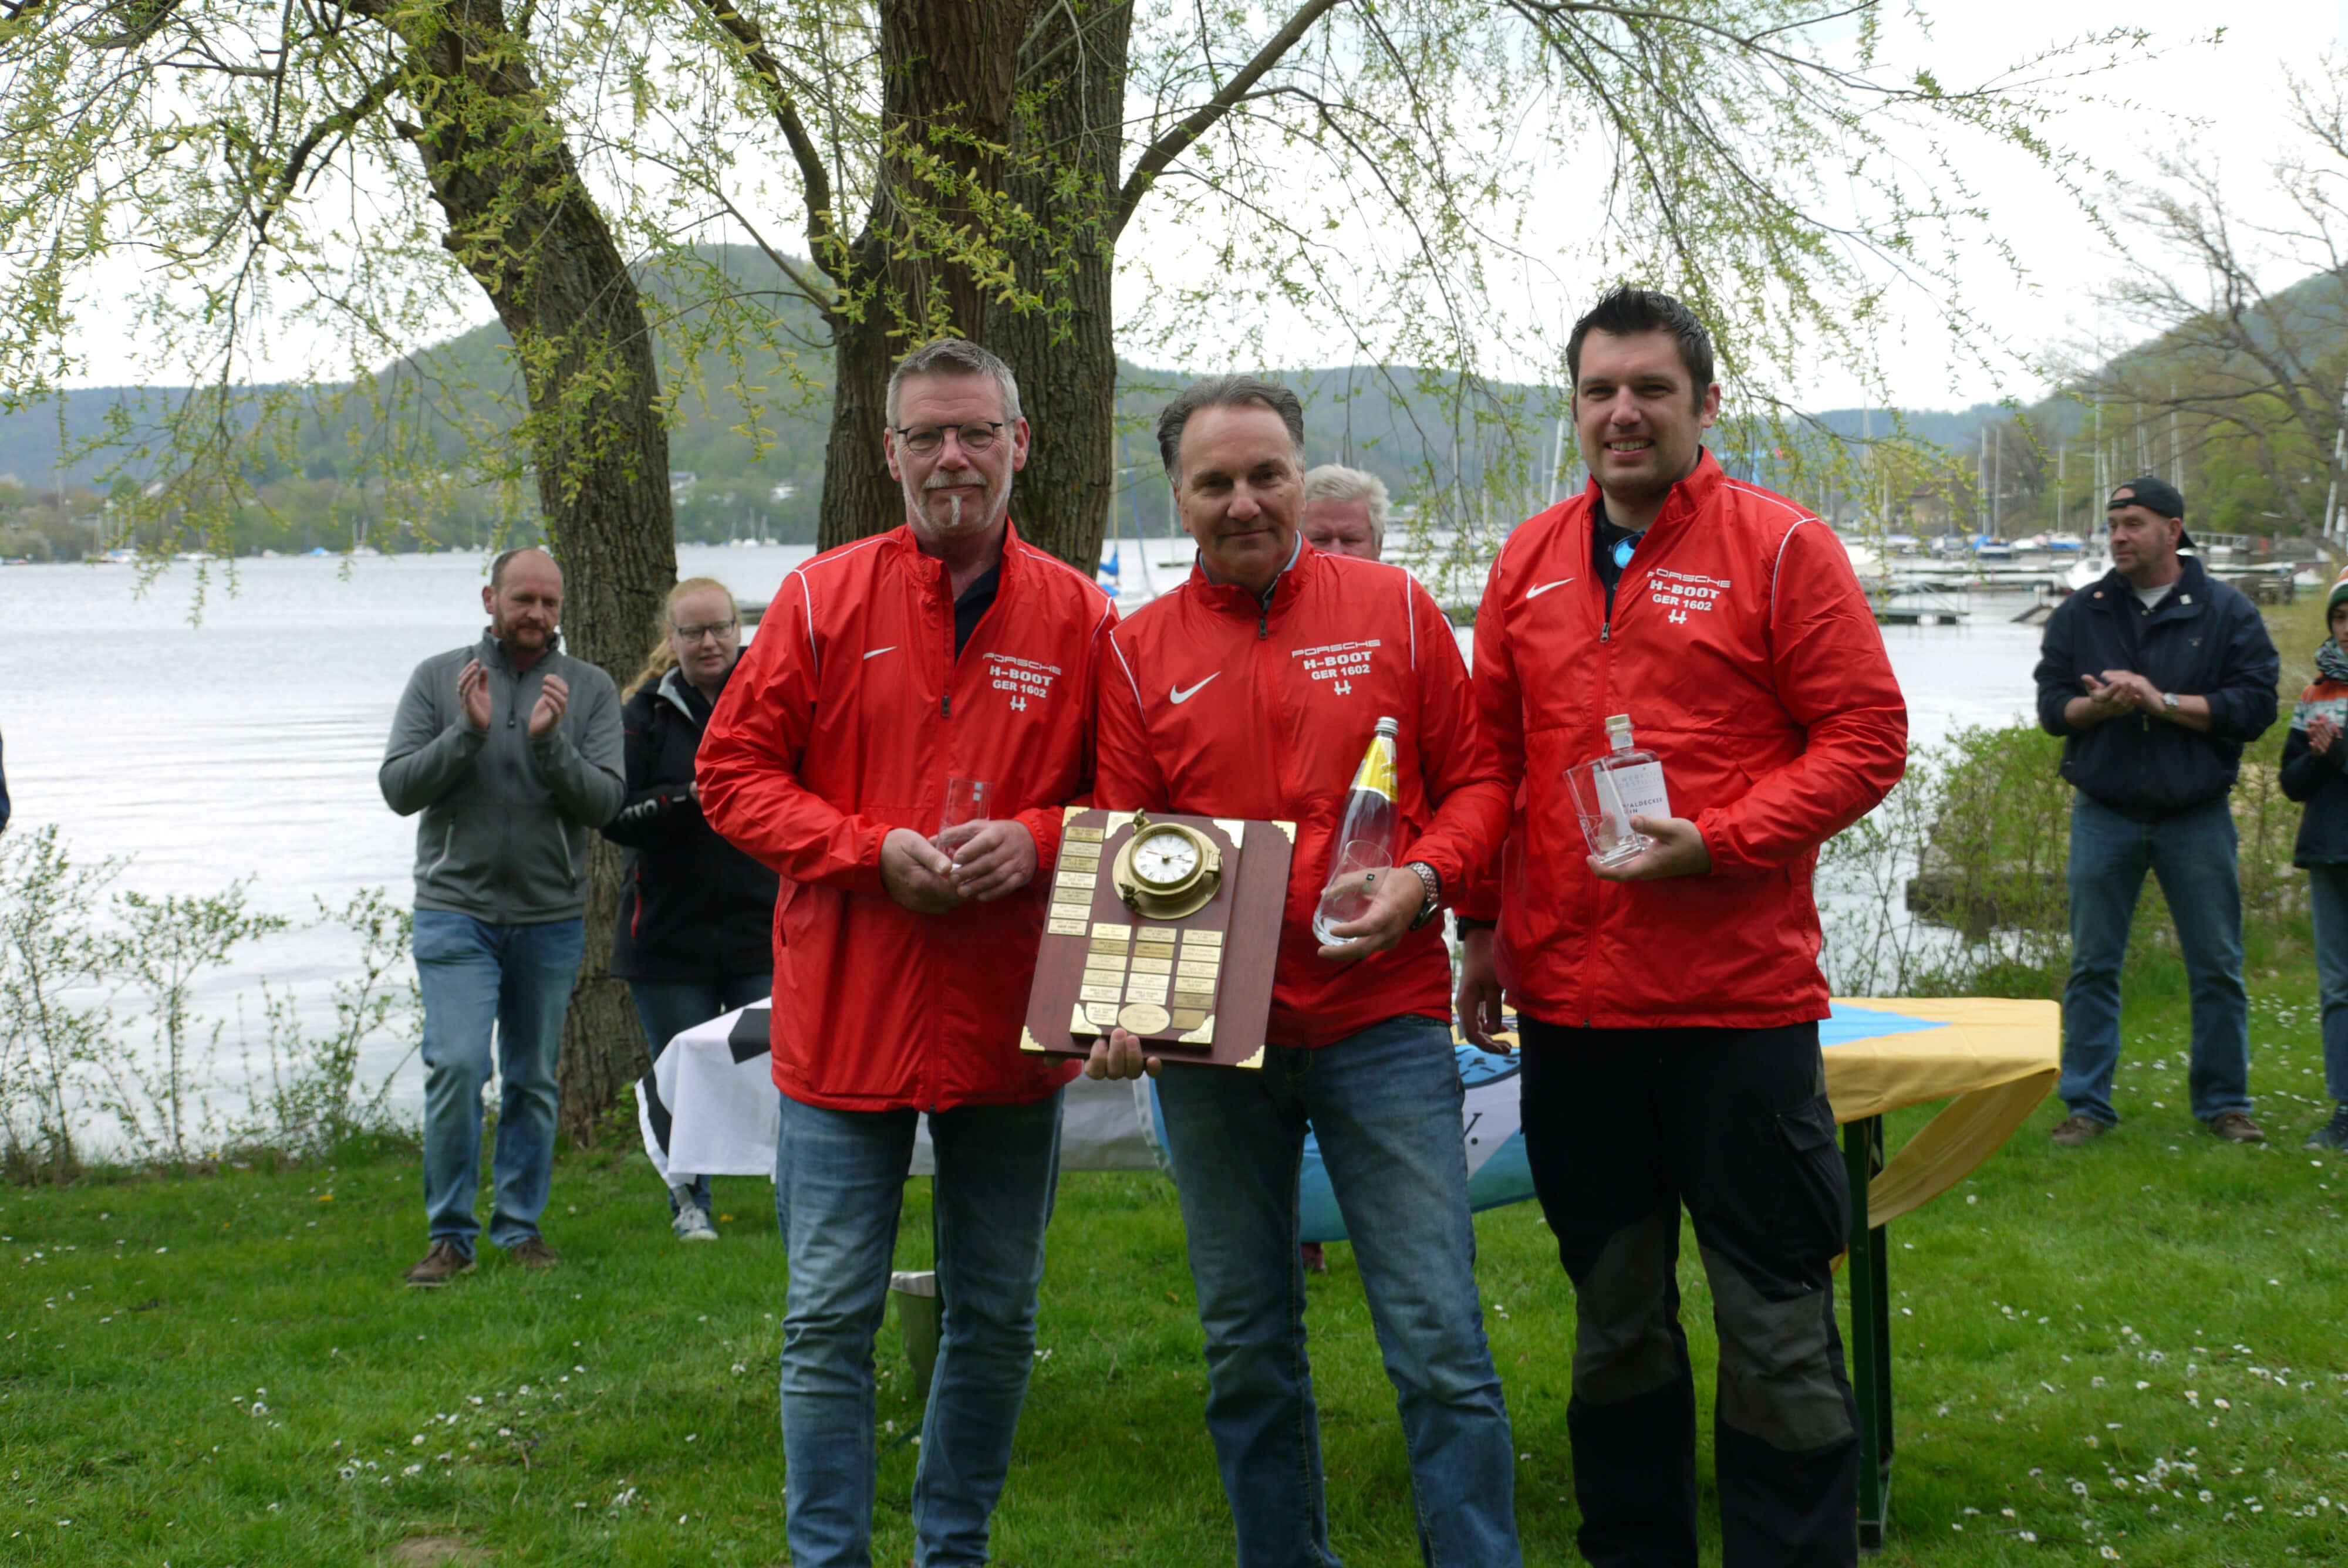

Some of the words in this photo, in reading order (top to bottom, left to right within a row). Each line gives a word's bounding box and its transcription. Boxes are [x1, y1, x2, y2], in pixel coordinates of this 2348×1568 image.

[1649, 579, 1720, 599] H-BOOT
[1653, 594, 1679, 606] GER
[1683, 599, 1712, 611] 1602
[1291, 639, 1381, 658] PORSCHE
[983, 653, 1061, 675] PORSCHE
[1303, 651, 1372, 670] H-BOOT
[990, 665, 1053, 687] H-BOOT
[1311, 669, 1337, 680] GER
[1341, 664, 1370, 676] 1602
[993, 680, 1017, 691] GER
[1020, 684, 1047, 698] 1602
